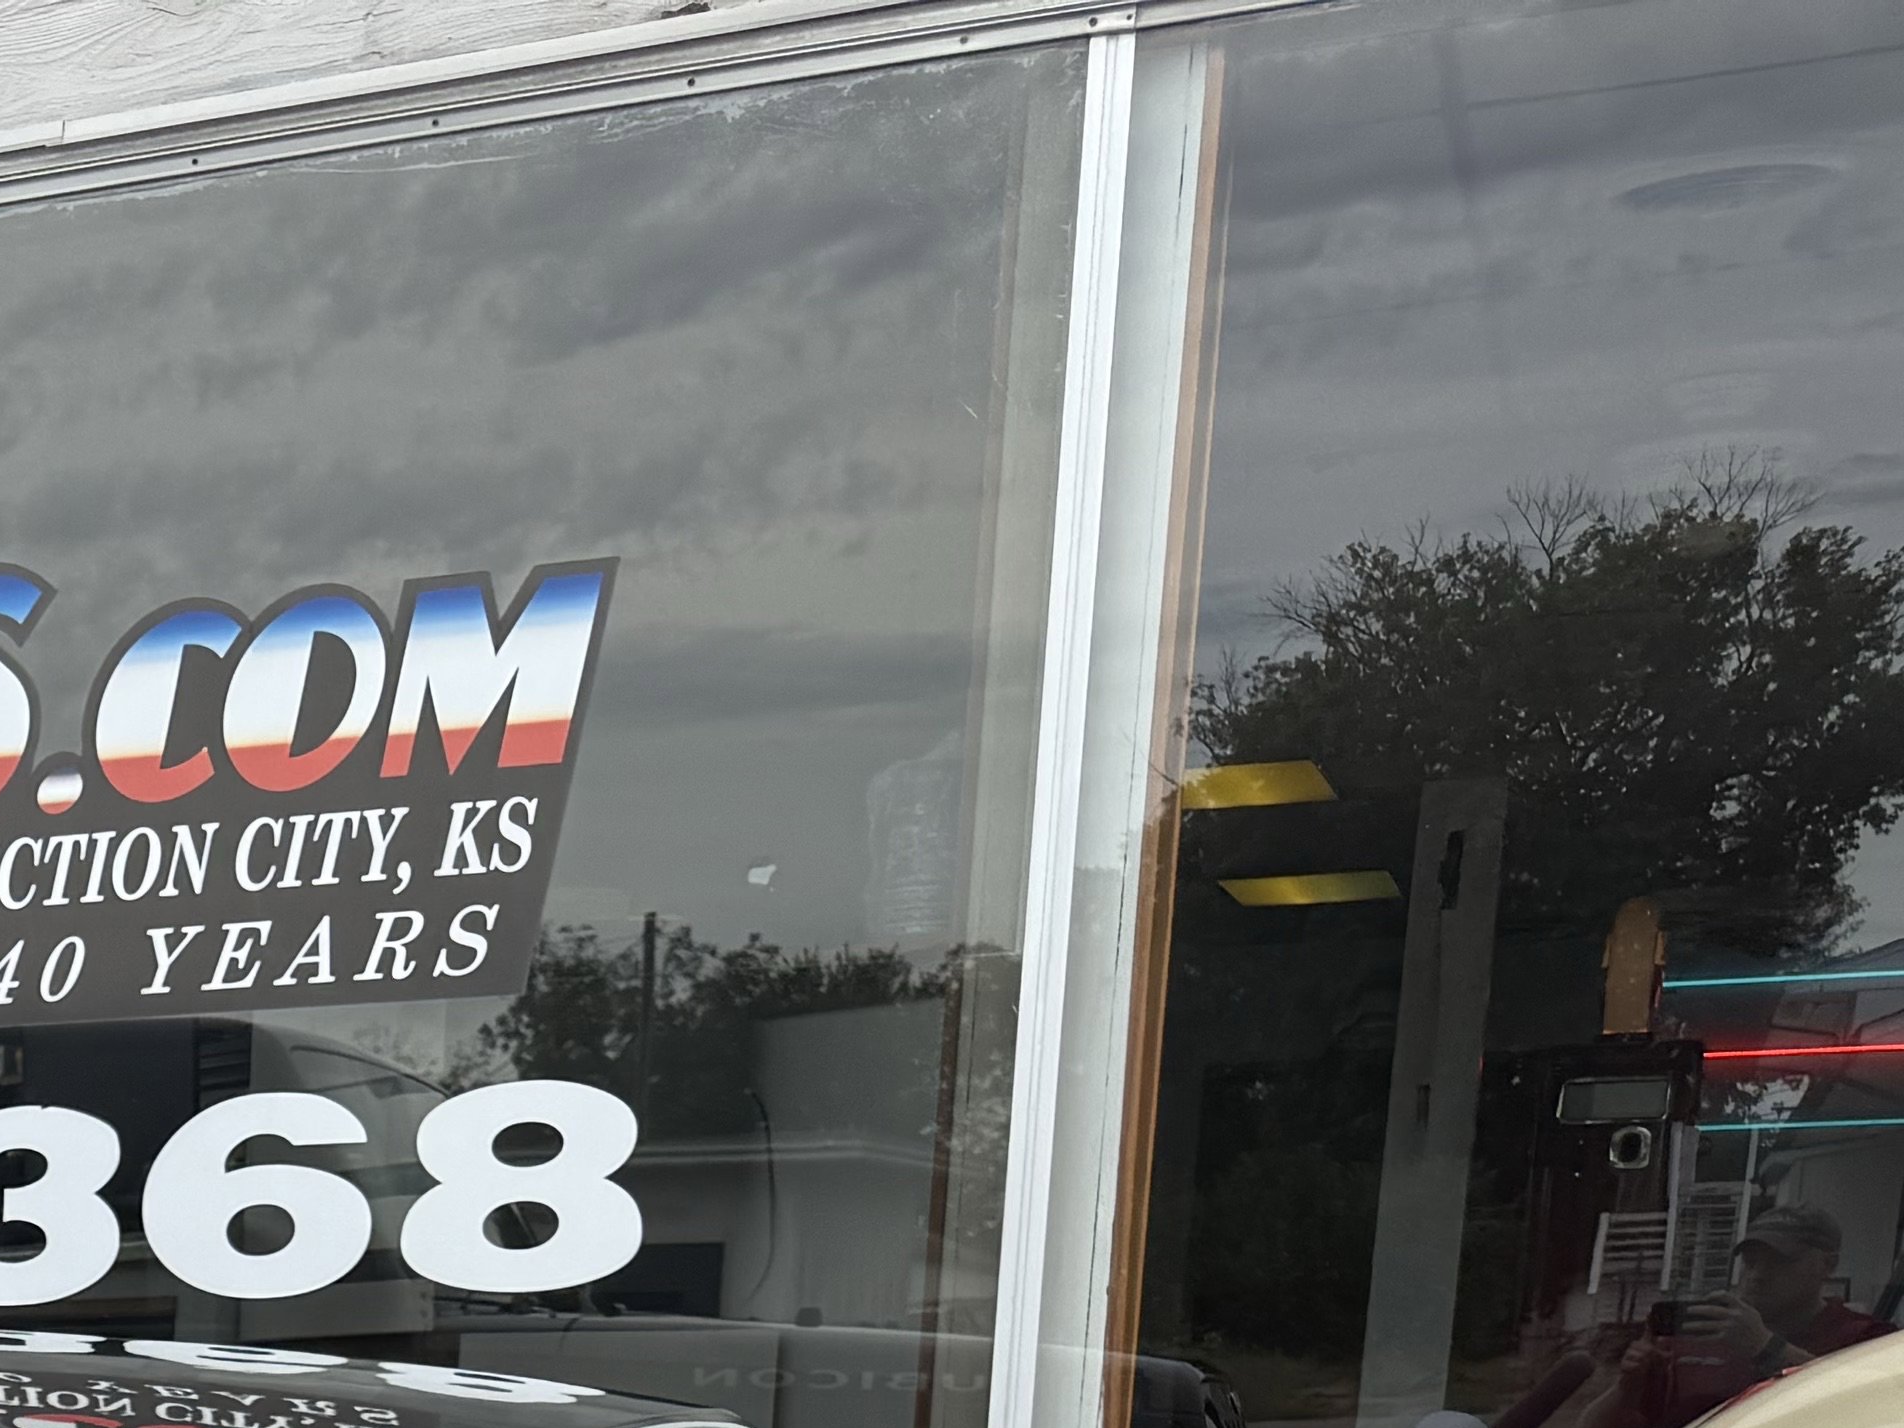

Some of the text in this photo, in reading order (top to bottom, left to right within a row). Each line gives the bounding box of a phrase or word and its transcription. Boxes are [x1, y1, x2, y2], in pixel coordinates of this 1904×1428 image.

[234, 806, 410, 893] CITY,
[434, 797, 538, 877] KS
[141, 904, 500, 996] YEARS
